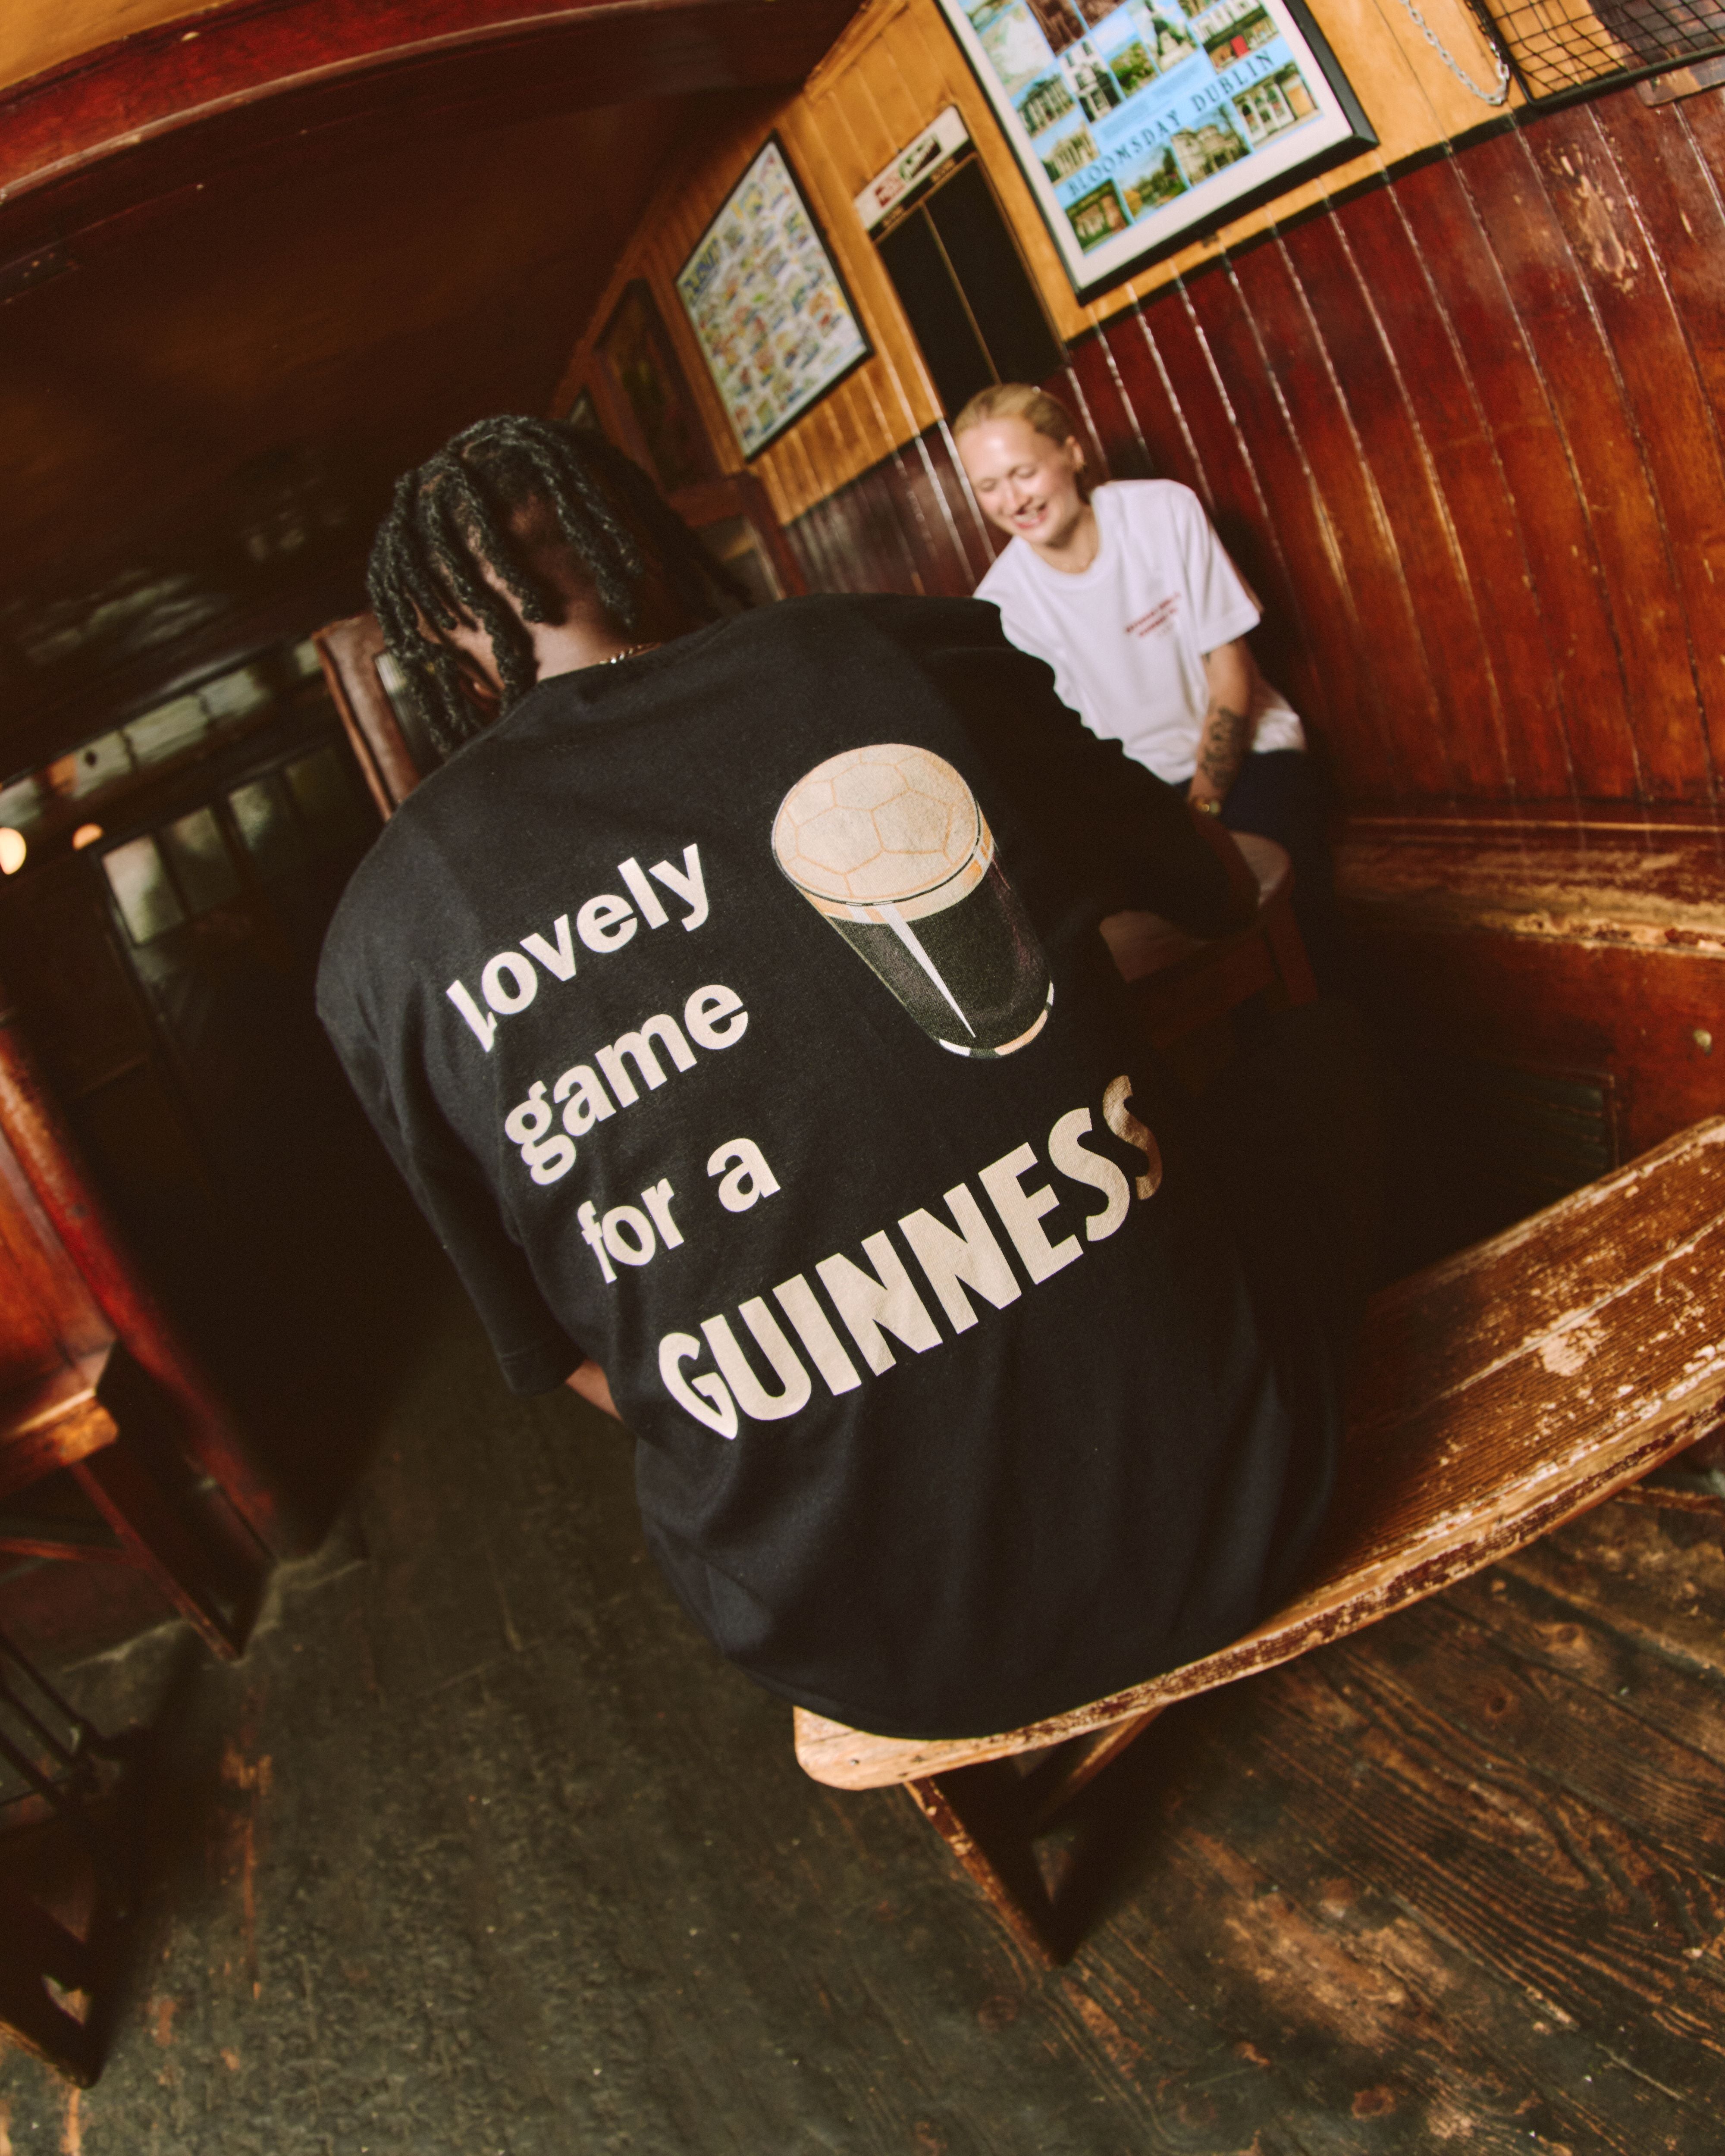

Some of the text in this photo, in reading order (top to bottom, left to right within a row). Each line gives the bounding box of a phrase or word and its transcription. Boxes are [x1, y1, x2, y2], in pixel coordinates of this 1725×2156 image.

[1189, 49, 1274, 112] DUBLIN
[505, 984, 749, 1186] game
[577, 1138, 781, 1284] for a
[659, 1075, 1163, 1440] GUINNESS
